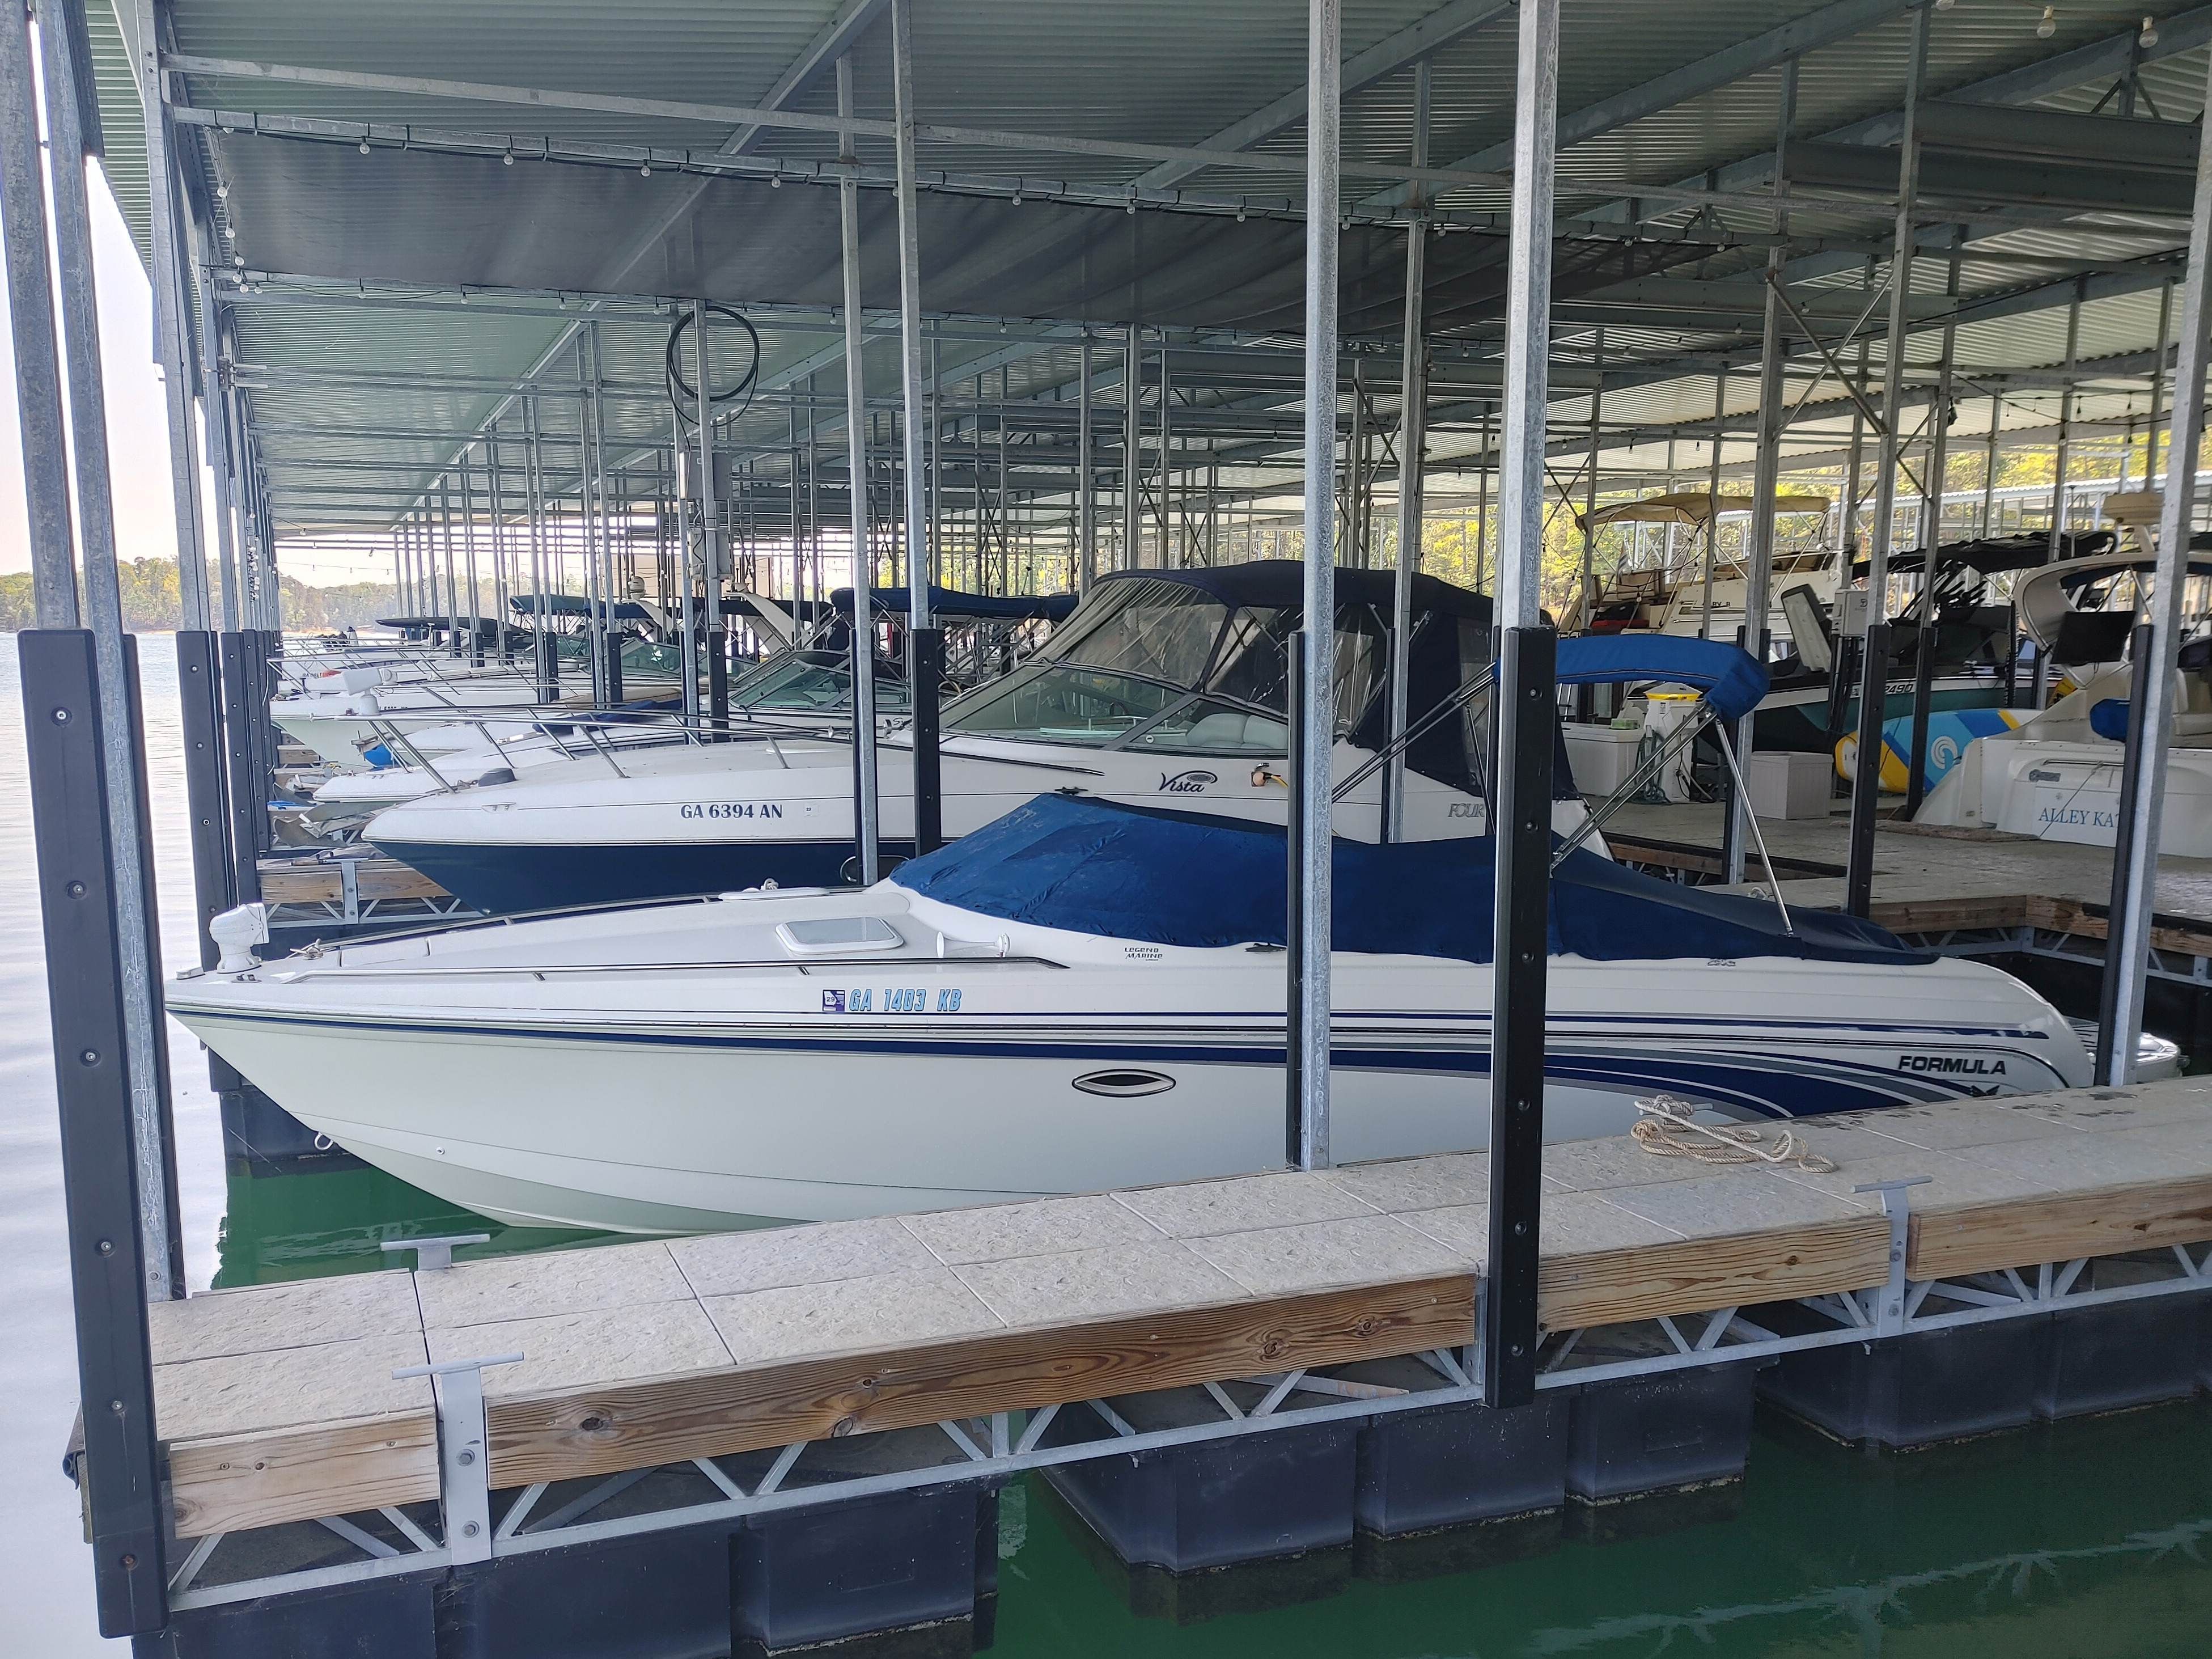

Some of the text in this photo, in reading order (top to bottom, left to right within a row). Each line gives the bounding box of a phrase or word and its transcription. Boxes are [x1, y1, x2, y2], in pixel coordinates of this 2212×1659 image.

[1158, 770, 1218, 792] Vista
[680, 804, 782, 819] GA 6394 AN
[2039, 807, 2090, 824] ALLEY
[849, 988, 962, 1012] GA 1403 KB
[1898, 1055, 2007, 1075] FORMULA
